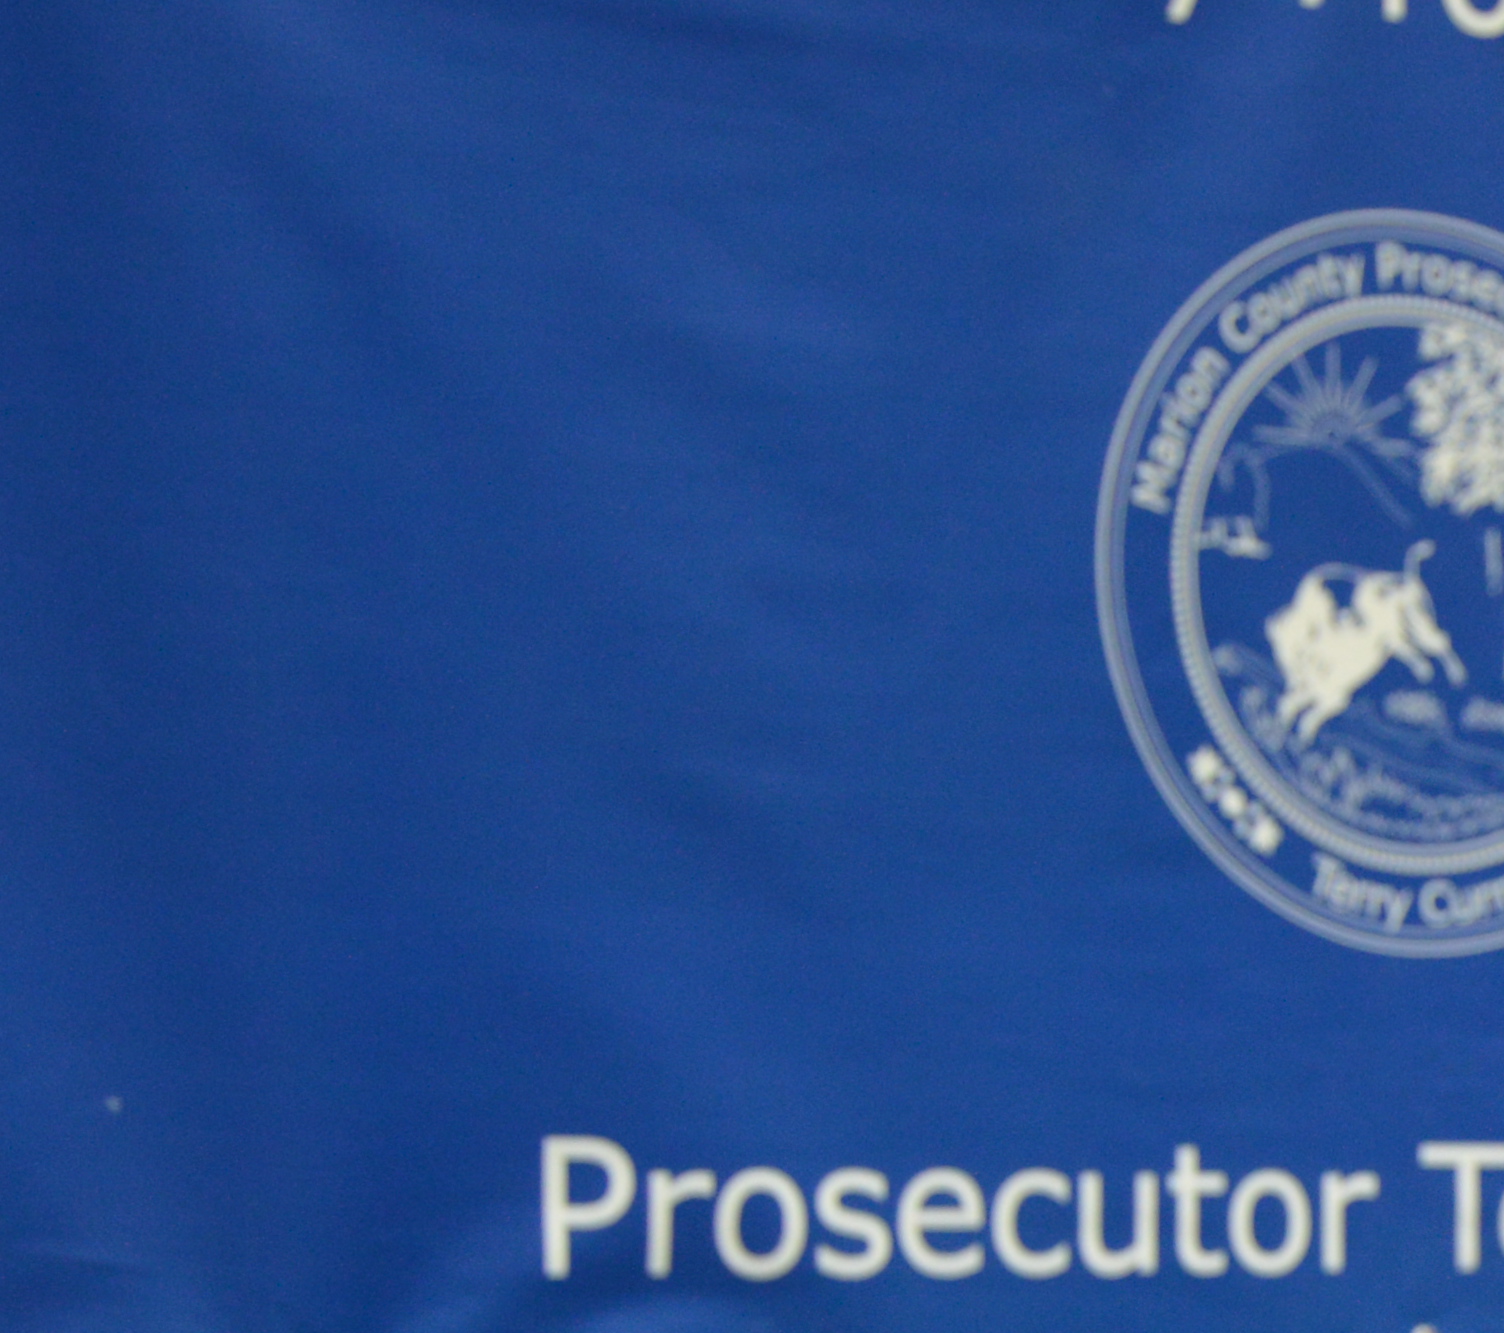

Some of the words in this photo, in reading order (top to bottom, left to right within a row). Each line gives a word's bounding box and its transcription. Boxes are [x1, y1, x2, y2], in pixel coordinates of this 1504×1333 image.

[1131, 346, 1231, 514] Marion
[1218, 254, 1364, 352] County
[1311, 852, 1412, 931] Terry
[540, 1132, 1381, 1281] Prosecutor
